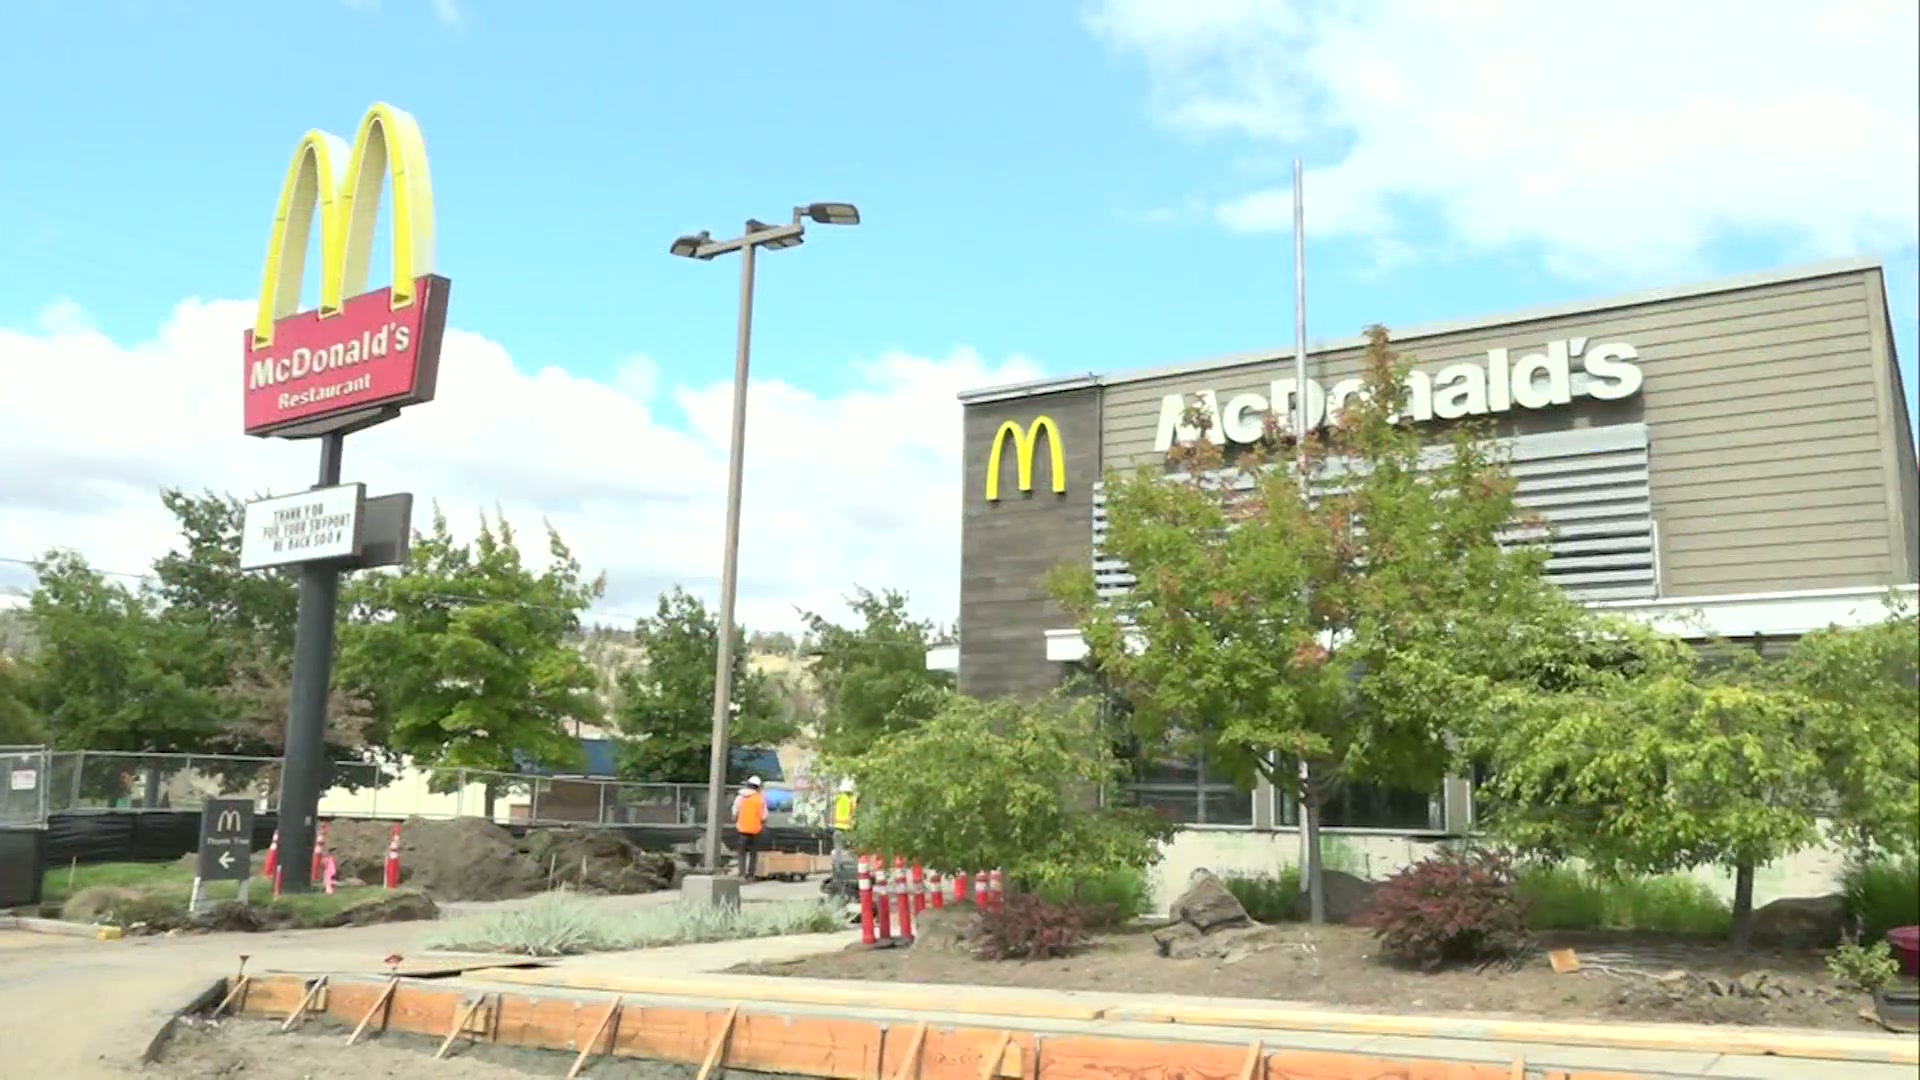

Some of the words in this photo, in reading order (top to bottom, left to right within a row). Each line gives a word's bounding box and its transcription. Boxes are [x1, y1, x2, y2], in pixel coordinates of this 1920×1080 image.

[249, 322, 410, 390] McDonald's
[278, 373, 371, 410] Restaurant
[264, 525, 280, 540] FOR
[283, 520, 306, 536] YOUR
[309, 513, 351, 531] SUPPORT
[273, 506, 302, 522] THANK
[288, 533, 311, 550] BACK
